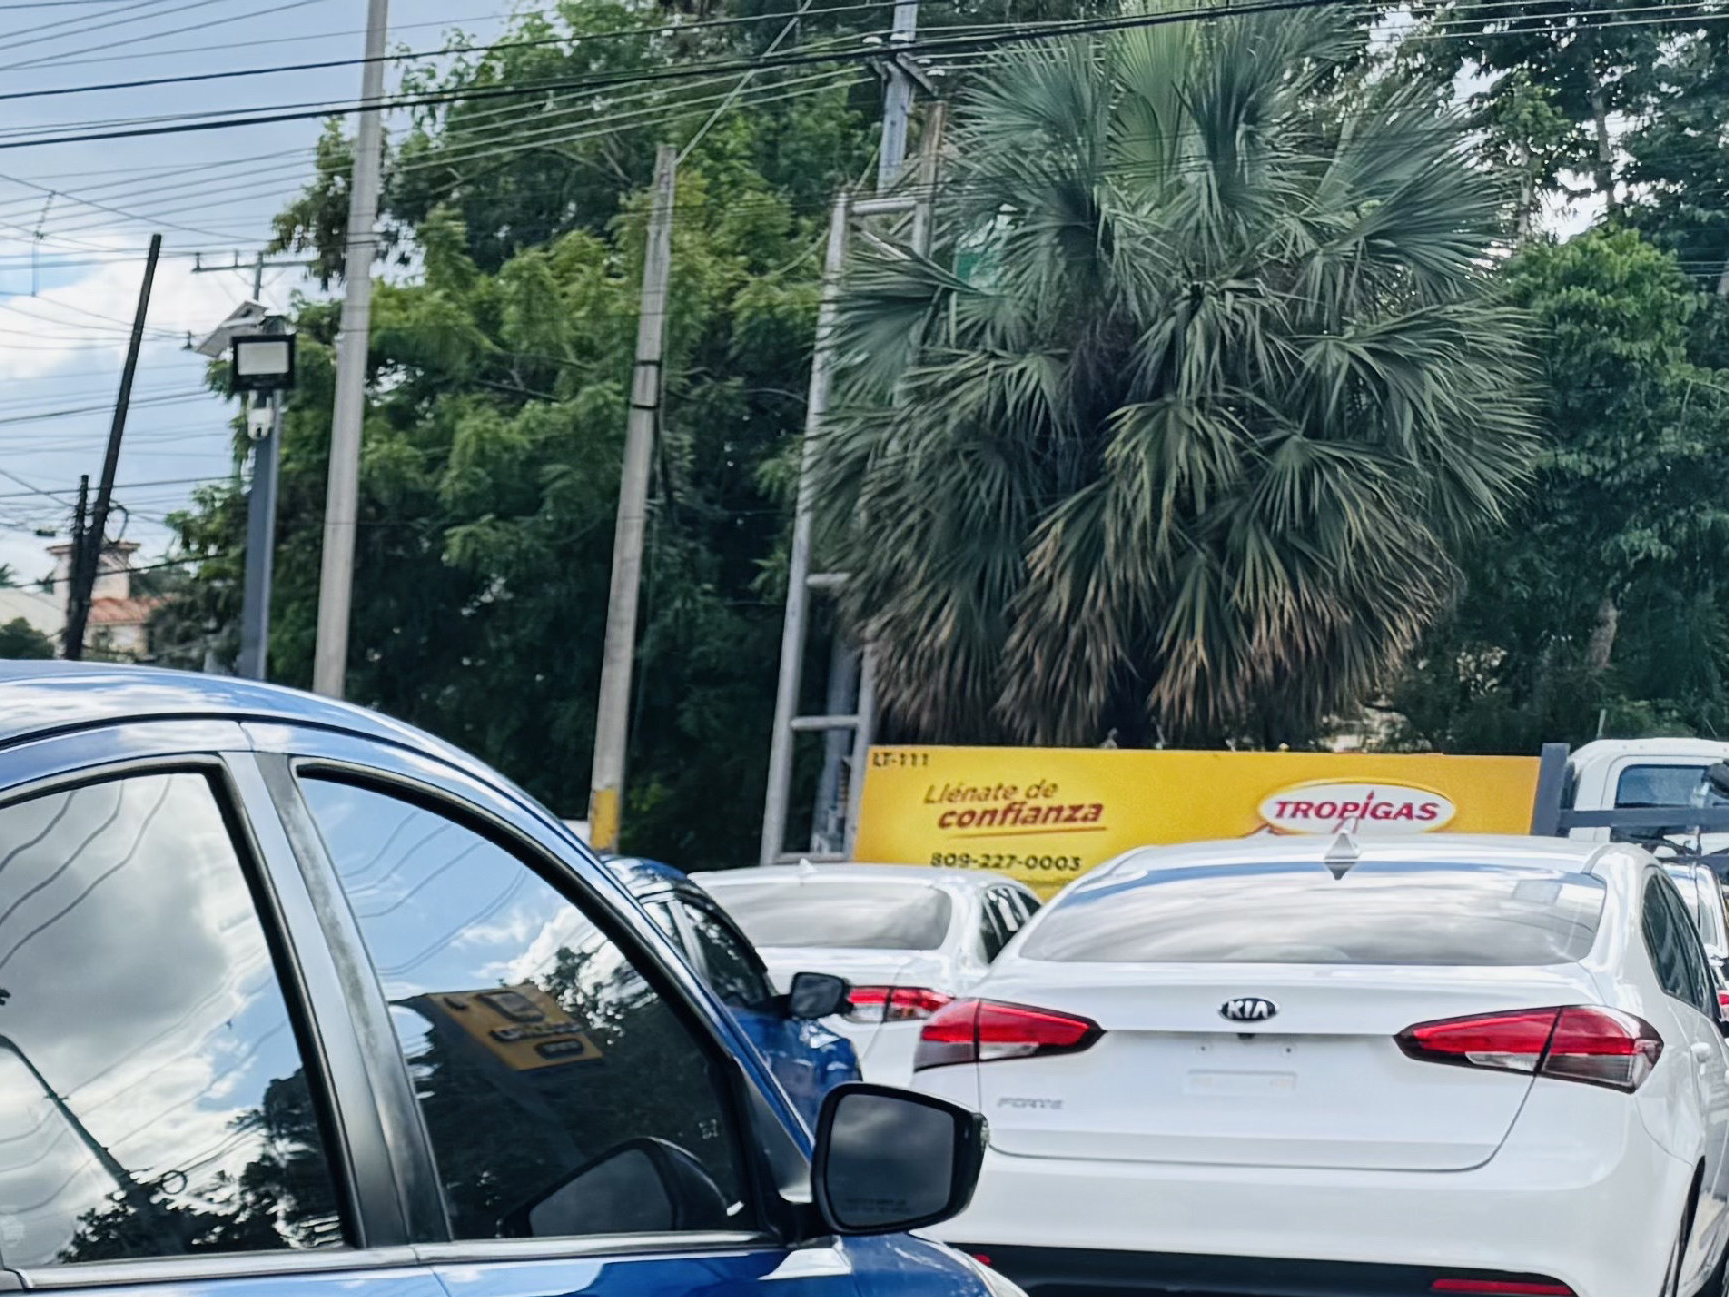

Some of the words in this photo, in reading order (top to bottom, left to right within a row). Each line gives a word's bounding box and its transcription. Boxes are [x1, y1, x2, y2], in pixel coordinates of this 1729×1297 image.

[923, 781, 1018, 804] Llénate
[1025, 779, 1059, 800] de
[938, 801, 1104, 829] confianza
[930, 852, 1081, 872] 809-227-0003
[1227, 1000, 1269, 1019] KIA
